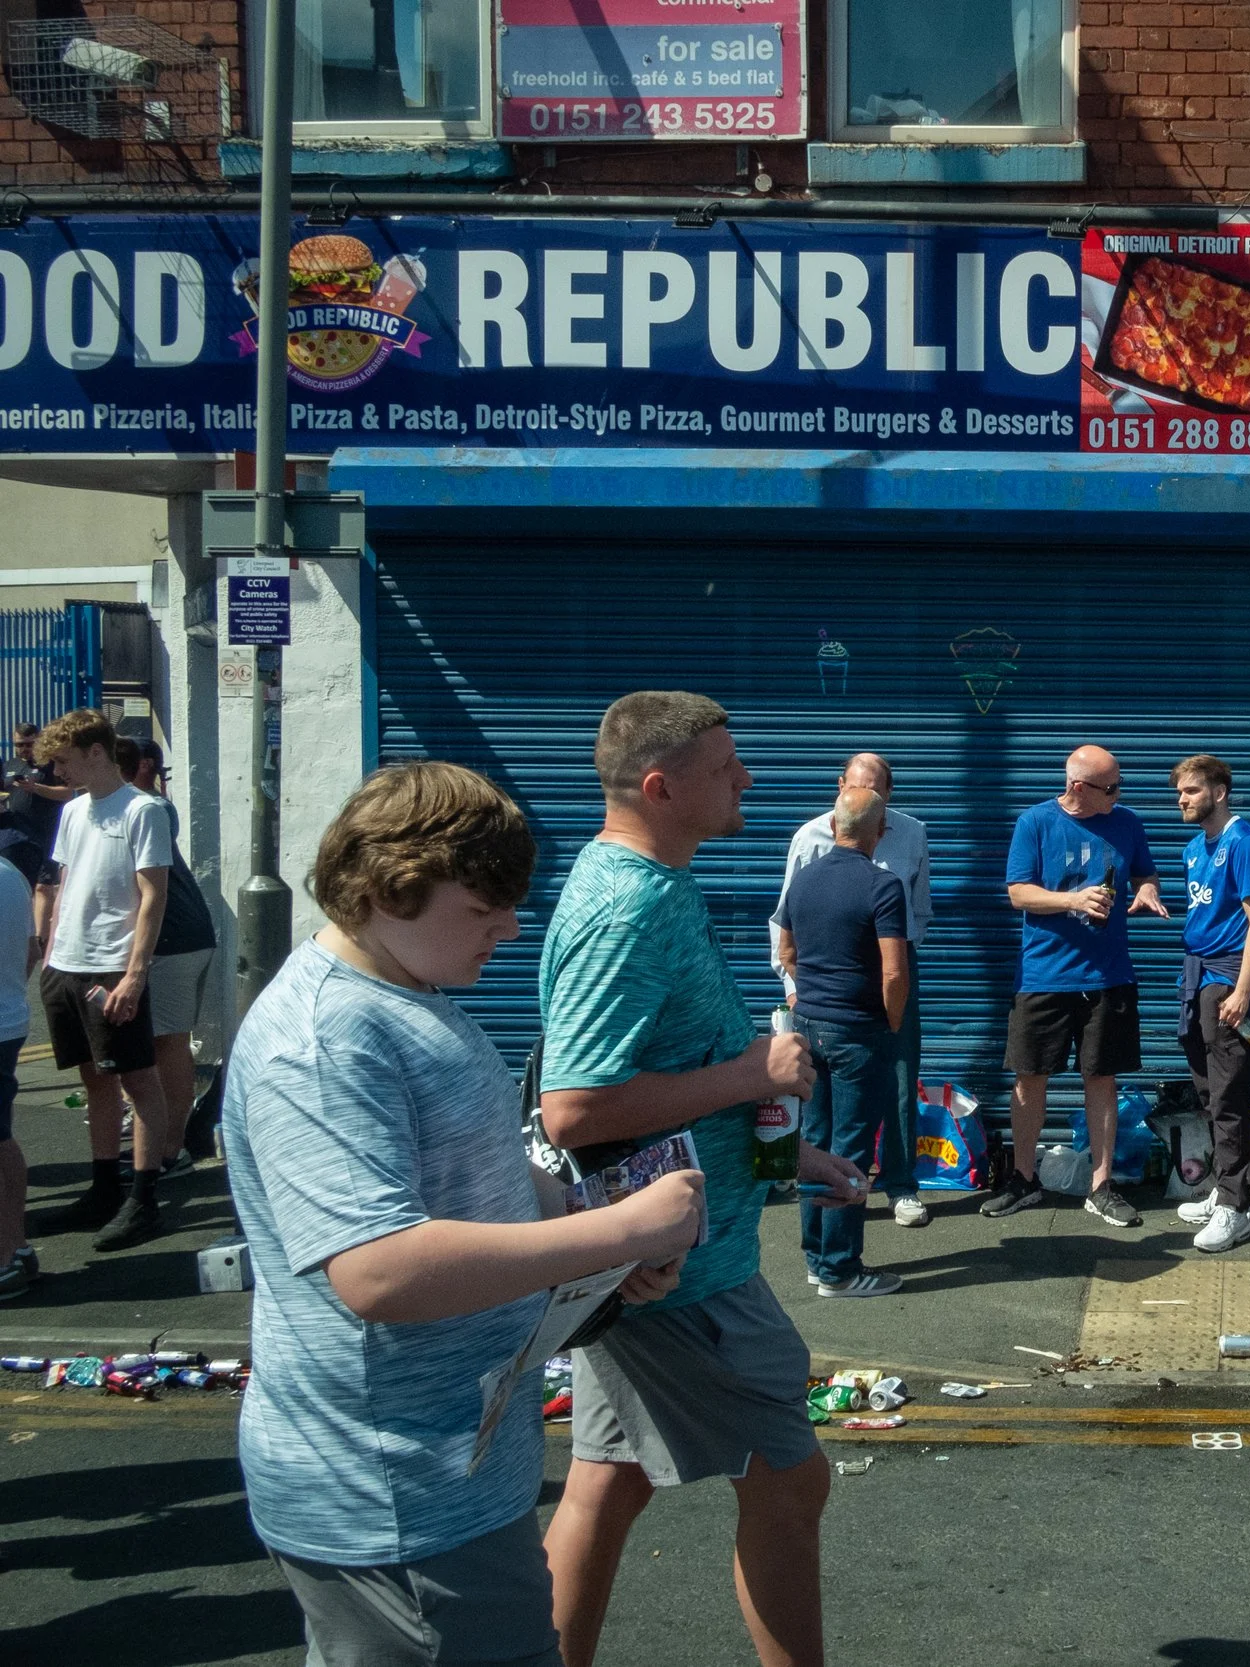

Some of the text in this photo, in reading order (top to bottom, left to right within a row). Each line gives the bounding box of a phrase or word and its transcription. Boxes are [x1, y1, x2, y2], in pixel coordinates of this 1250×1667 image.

[656, 34, 774, 61] for sale
[512, 70, 774, 86] freehold inc. café & 5 bed flat
[530, 102, 775, 131] 0151 243 5325
[1104, 235, 1173, 254] ORIGINAL
[1178, 236, 1241, 254] DETROIT
[313, 308, 400, 335] REPUBLIC
[458, 249, 1076, 375] REPUBLIC
[94, 403, 196, 434] Pizzeria,
[291, 403, 353, 430] Pizza
[361, 404, 380, 430] &
[388, 404, 467, 434] Pasta,
[476, 403, 632, 435] Detroit-Style
[640, 405, 712, 436] Pizza,
[720, 405, 825, 433] Gourmet
[834, 406, 931, 439] Burgers
[938, 408, 957, 434] &
[966, 408, 1074, 436] Desserts
[1088, 417, 1154, 449] 0151
[1167, 418, 1219, 450] 288
[240, 590, 278, 598] Cameras
[247, 579, 270, 588] CCTV
